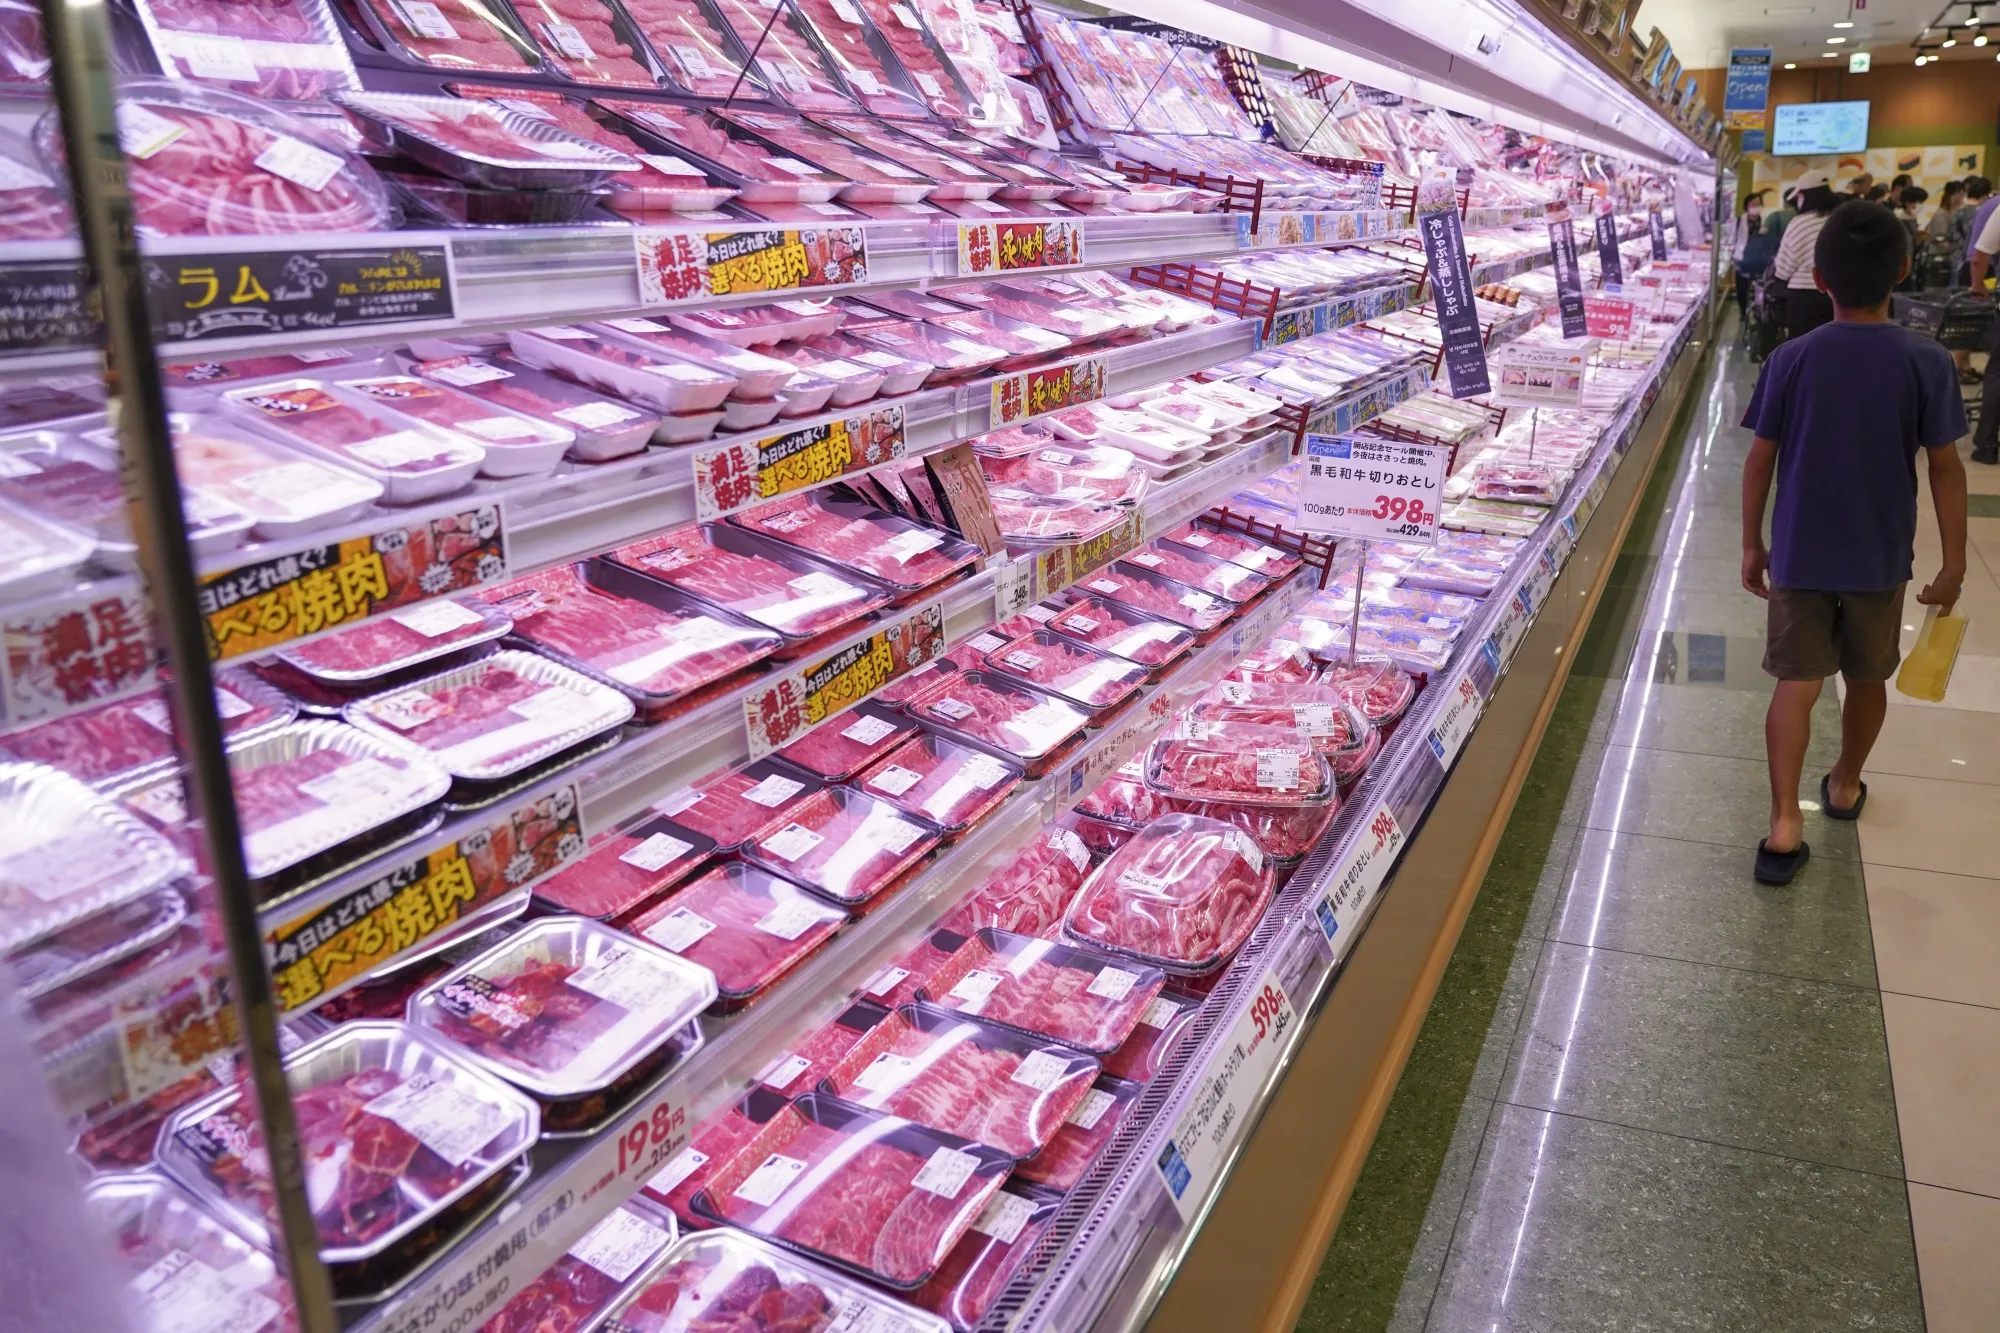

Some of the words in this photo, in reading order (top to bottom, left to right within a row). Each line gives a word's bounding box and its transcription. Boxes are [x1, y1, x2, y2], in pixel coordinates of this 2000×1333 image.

[179, 265, 271, 309] ラム
[710, 241, 810, 296] 選べる焼肉
[1429, 219, 1459, 316] 冷しゃぶ&蒸ししゃぶ
[758, 431, 852, 498] 選べる焼肉
[1353, 441, 1436, 458] 開店記念セール開催中、
[1353, 451, 1427, 467] 今夜はささっと焼肉。
[1310, 464, 1436, 489] 黒毛和牛切りおとし
[1303, 503, 1345, 516] 100gあたり
[1372, 494, 1435, 525] 398円
[806, 641, 895, 725] 選べる焼肉
